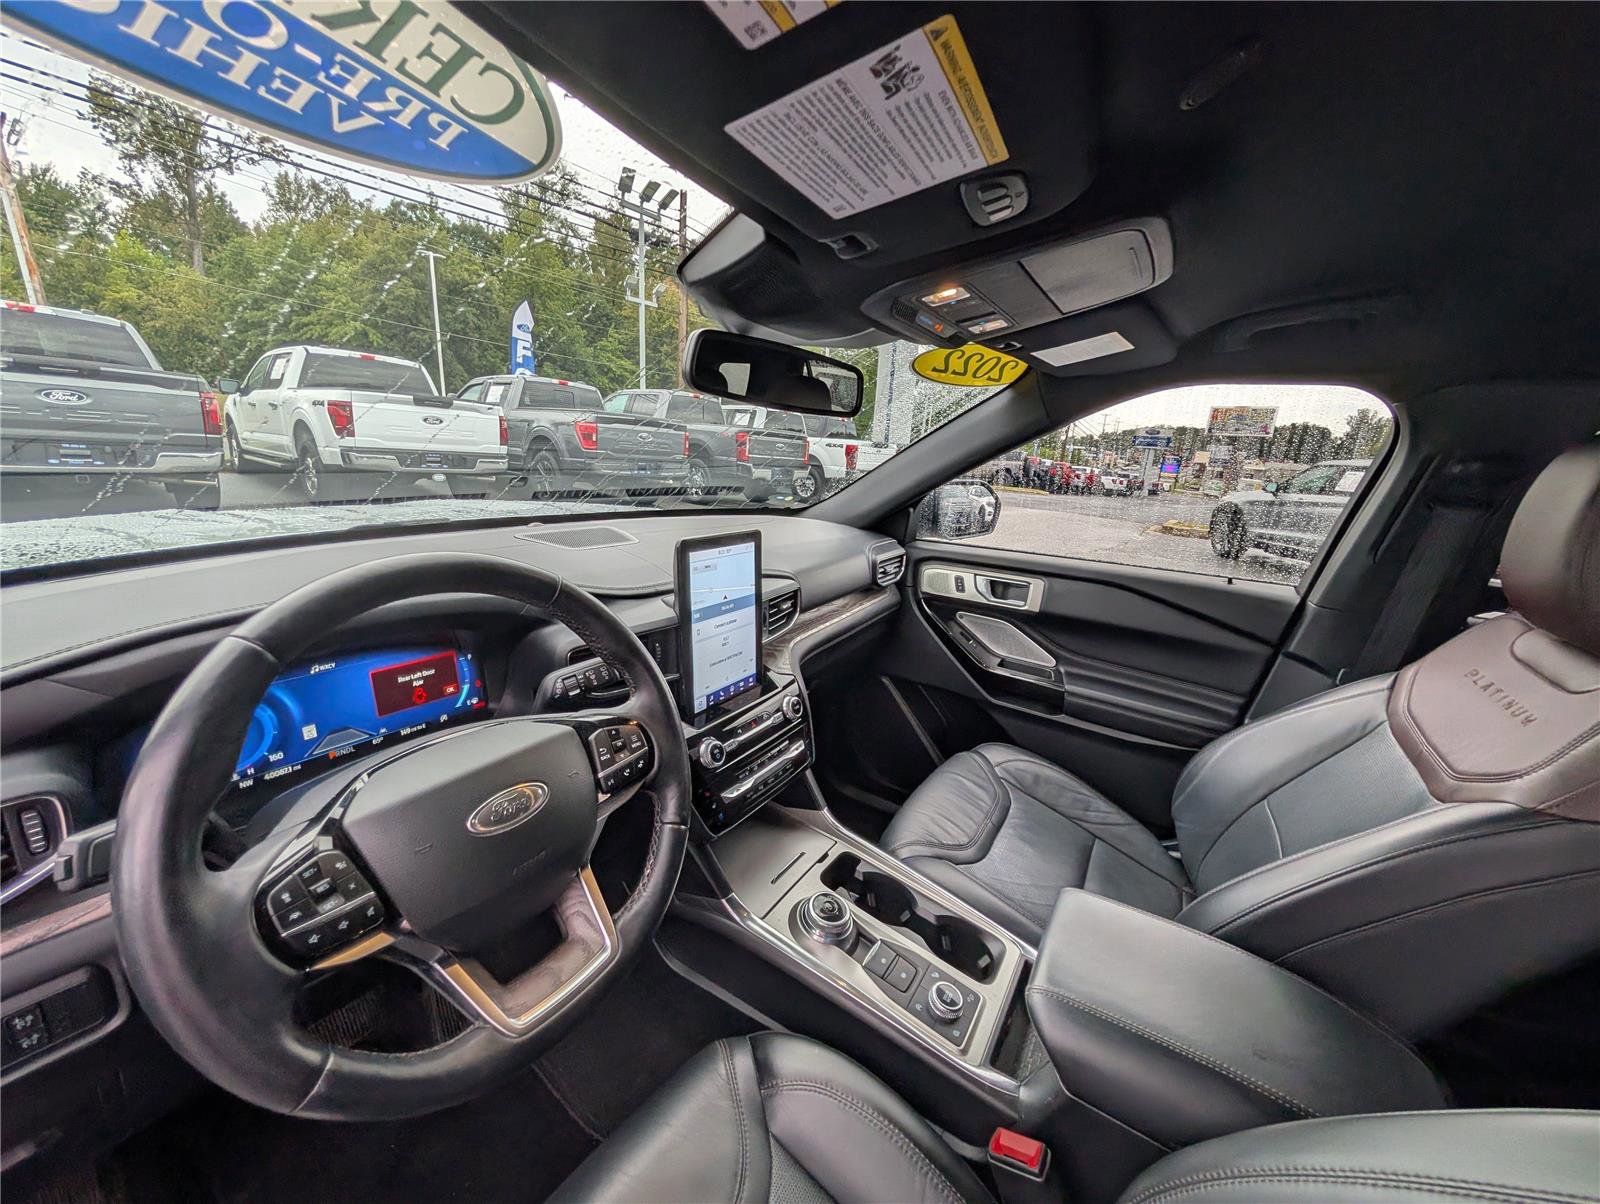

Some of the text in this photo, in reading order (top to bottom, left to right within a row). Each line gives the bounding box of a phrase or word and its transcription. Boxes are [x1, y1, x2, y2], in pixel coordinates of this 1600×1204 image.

[411, 672, 422, 680] Left
[1463, 668, 1538, 727] PLATINUM
[268, 752, 284, 763] 160
[239, 779, 254, 789] NW
